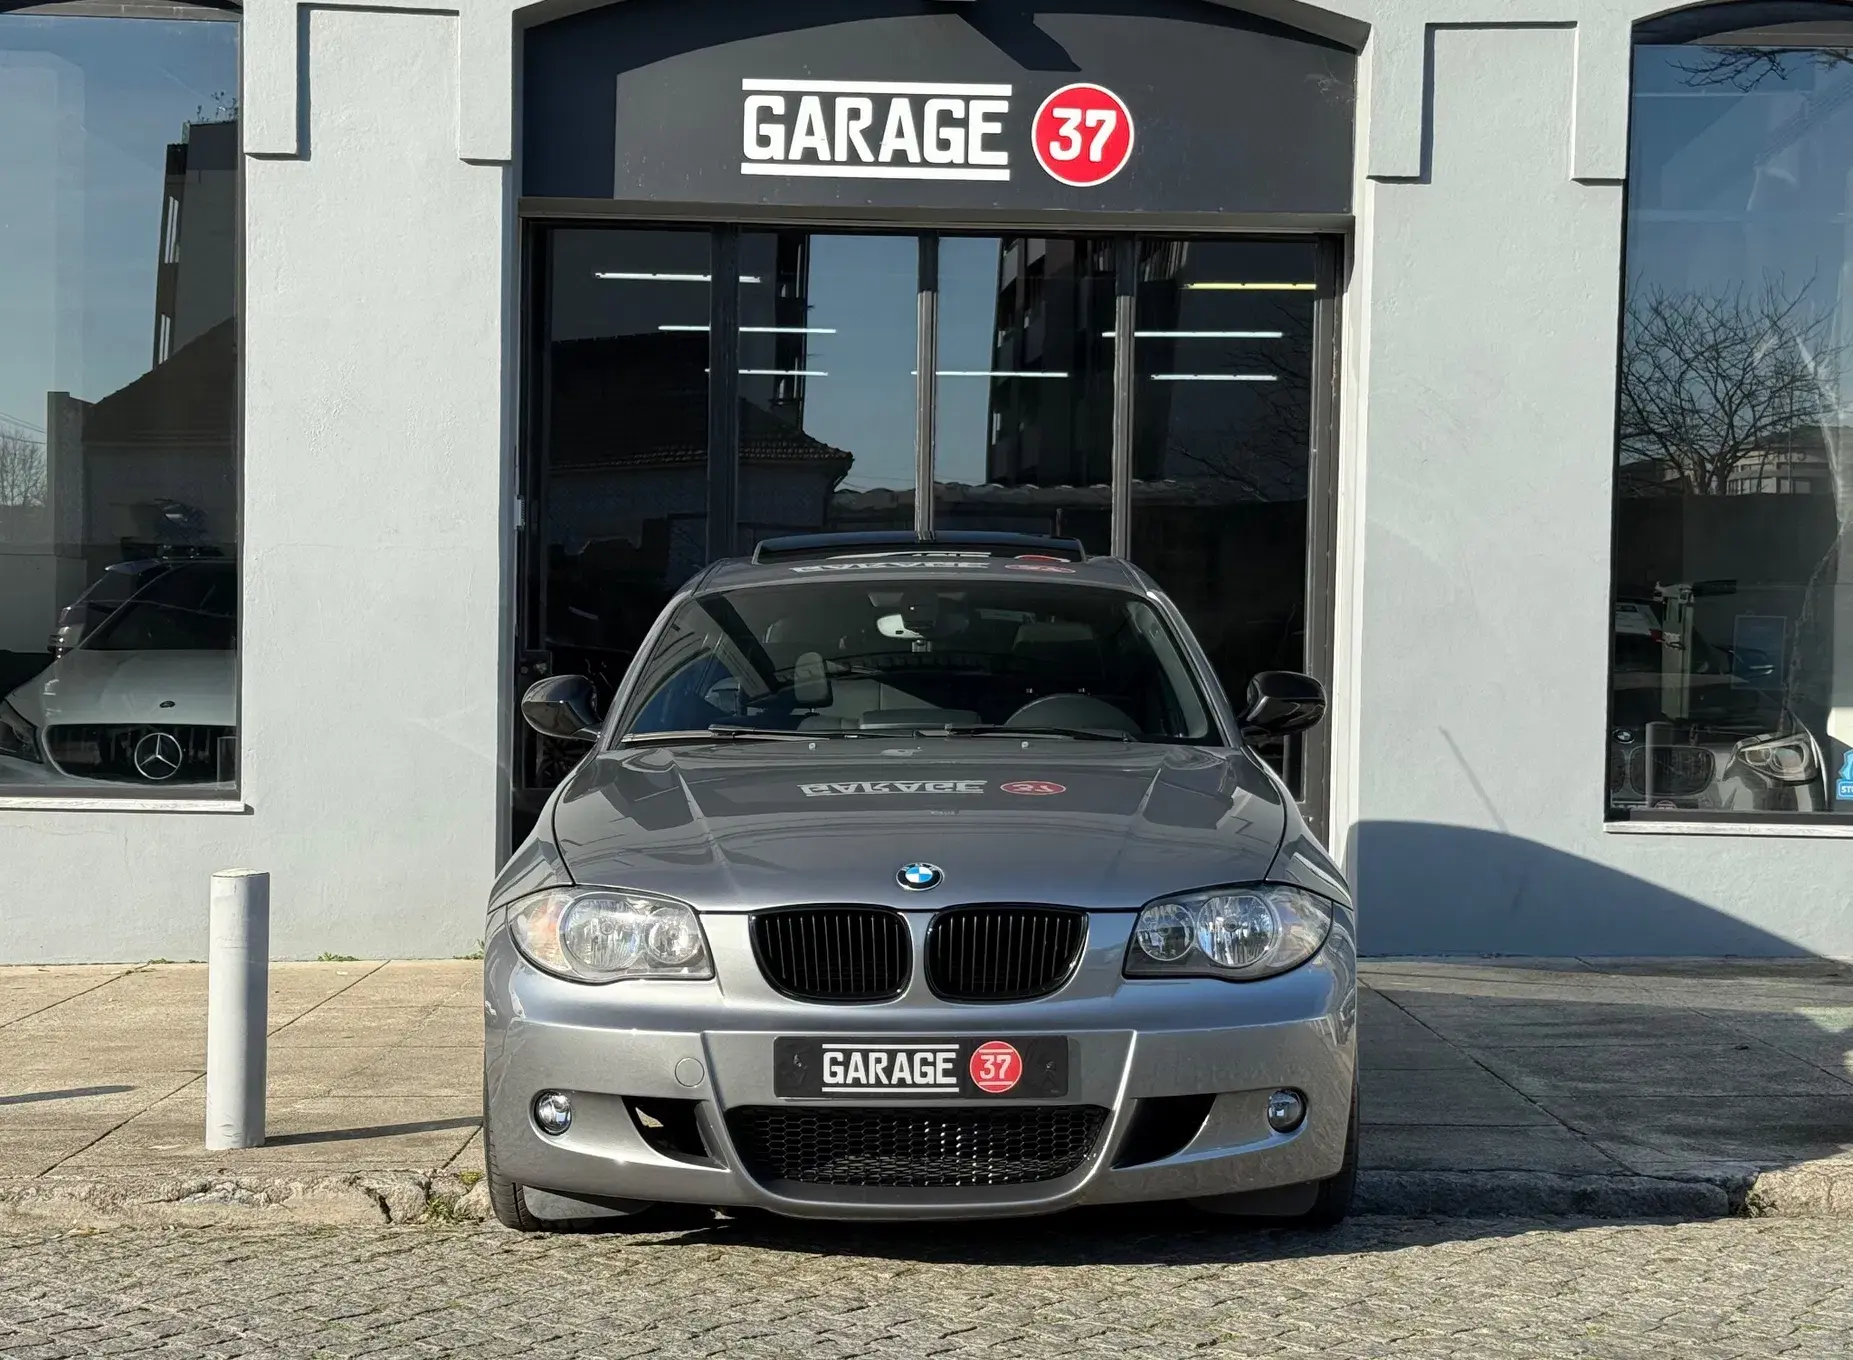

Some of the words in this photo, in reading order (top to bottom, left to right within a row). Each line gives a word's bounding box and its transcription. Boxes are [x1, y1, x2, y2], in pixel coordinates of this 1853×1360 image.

[743, 95, 1009, 165] GARAGE
[1049, 108, 1117, 162] 37
[822, 1052, 957, 1085] GARAGE
[979, 1055, 1012, 1080] 37
